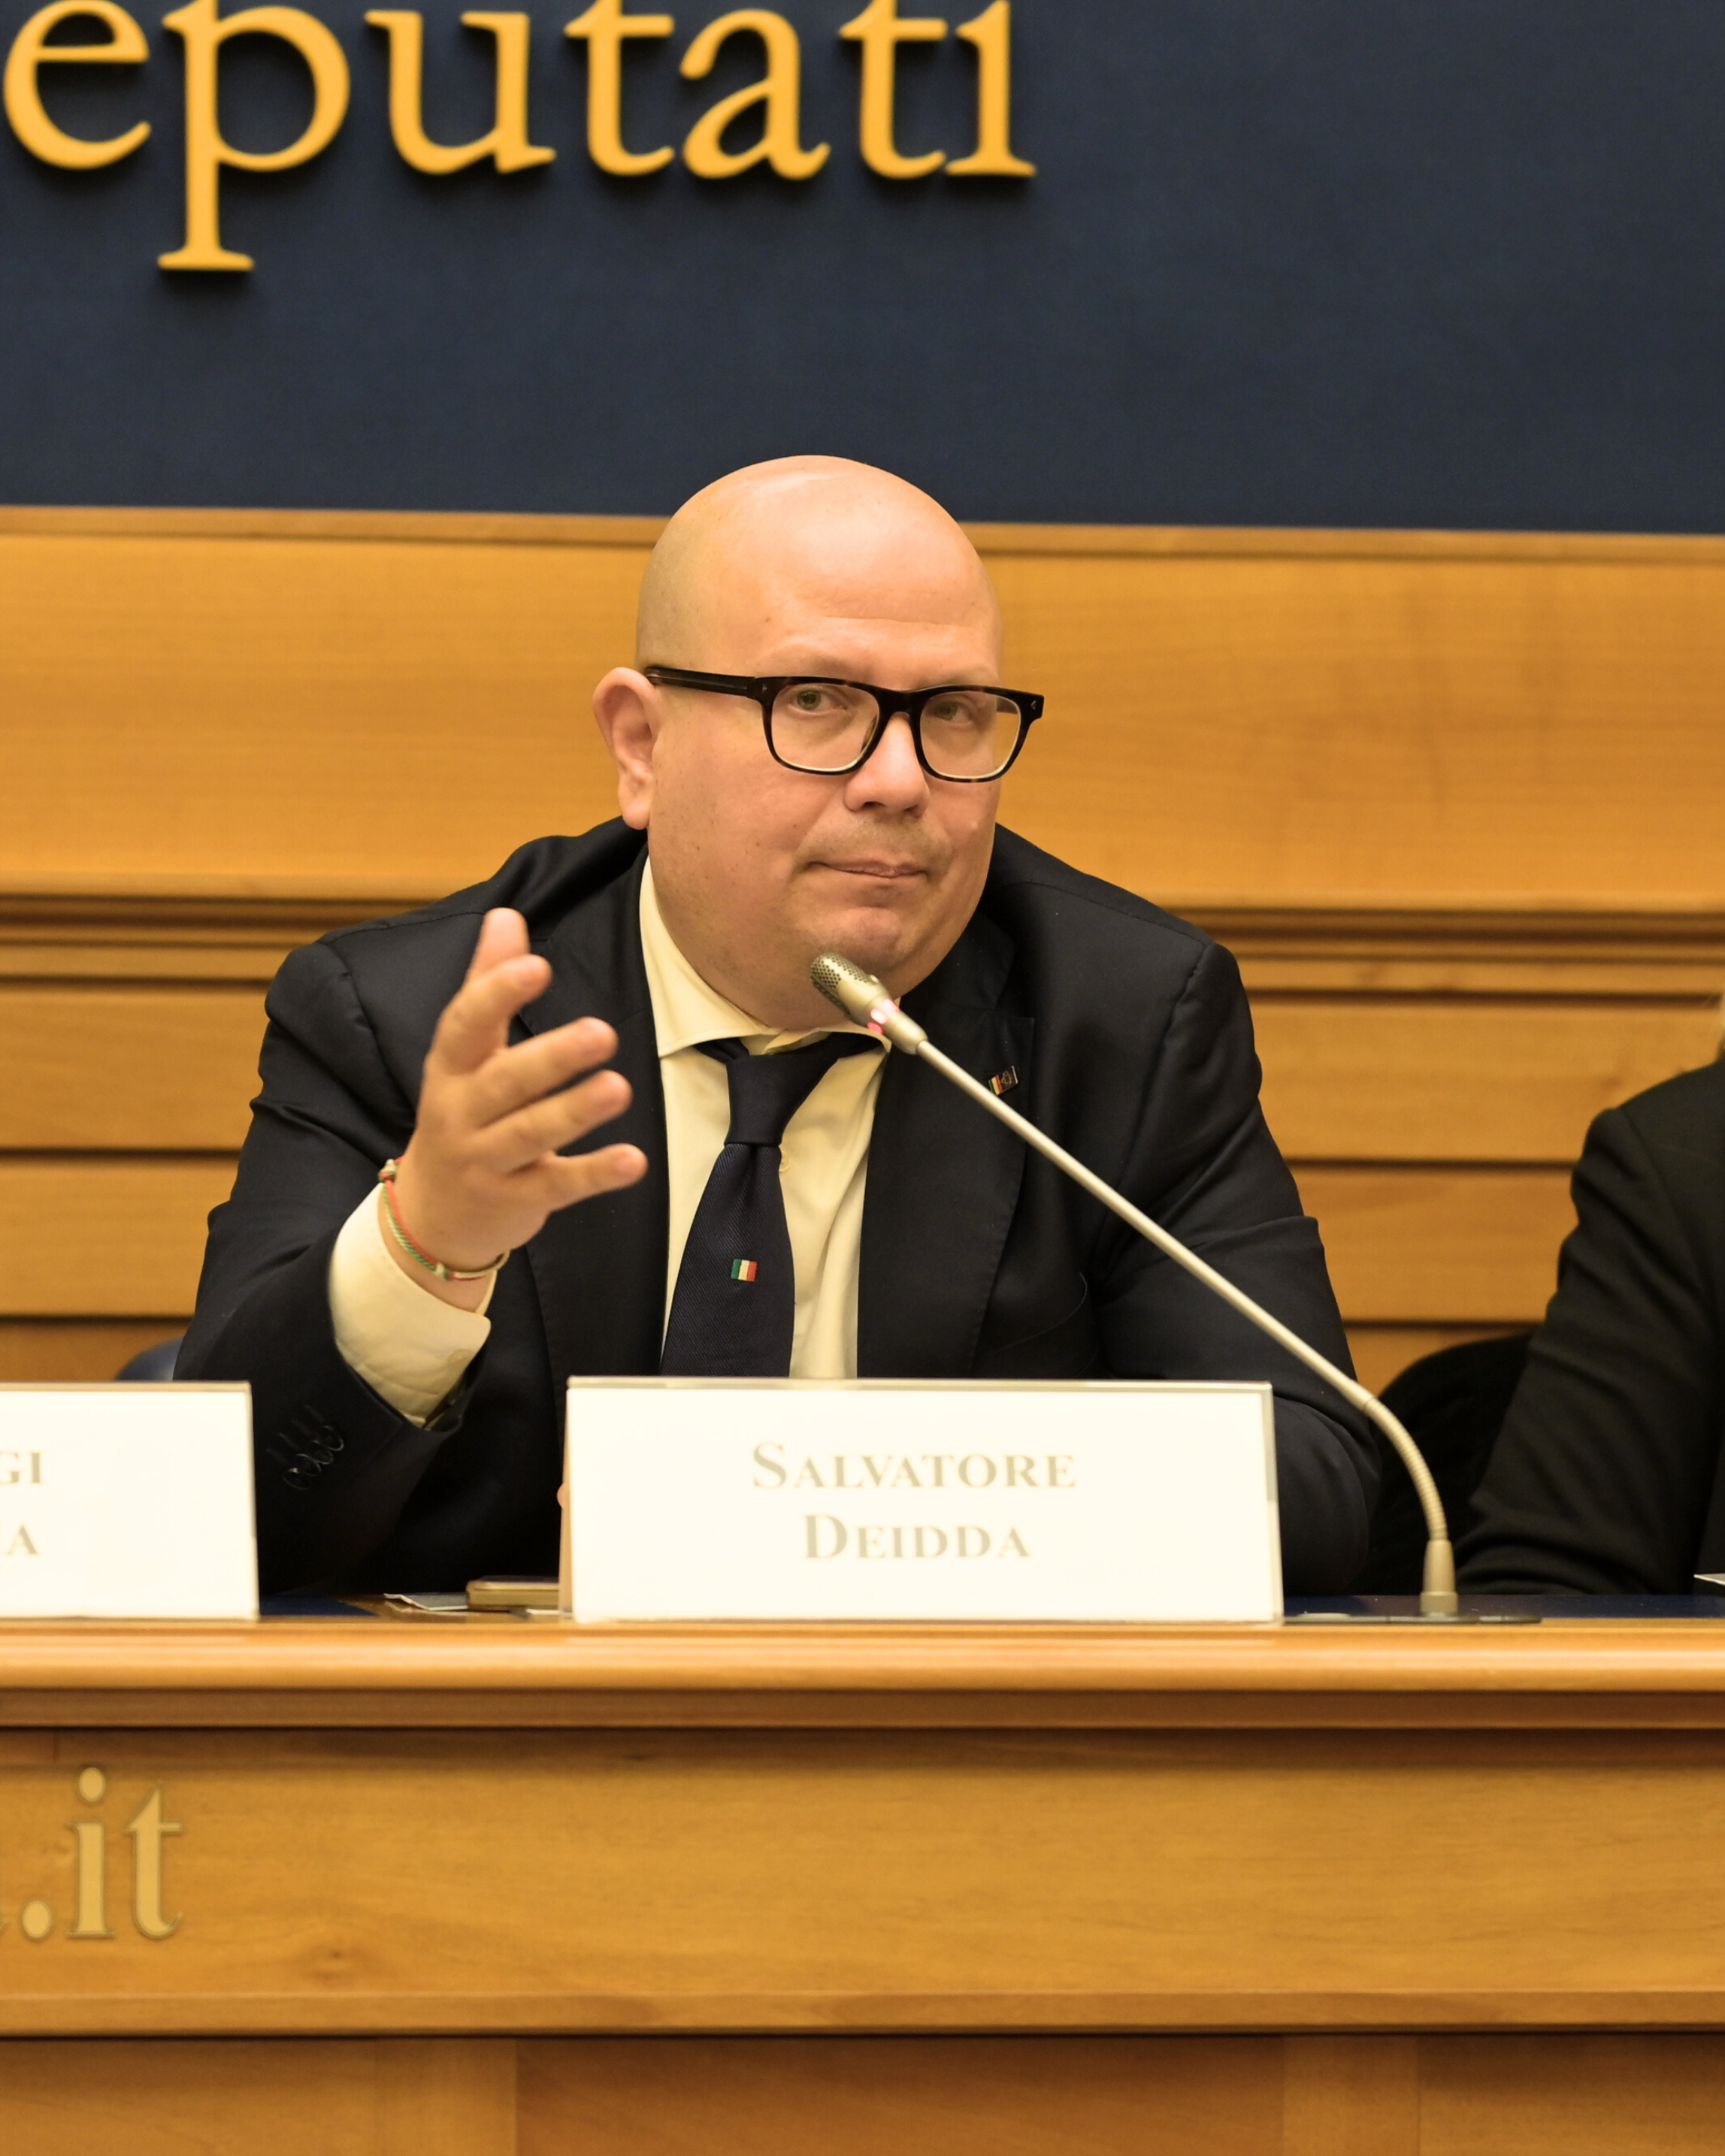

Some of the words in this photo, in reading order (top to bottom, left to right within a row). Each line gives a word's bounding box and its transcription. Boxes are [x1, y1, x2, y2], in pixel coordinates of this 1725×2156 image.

[2, 0, 1037, 271] eputati
[752, 1441, 1077, 1489] SALVATORE
[803, 1513, 1032, 1560] DEIDDA
[0, 1766, 183, 1940] .it
